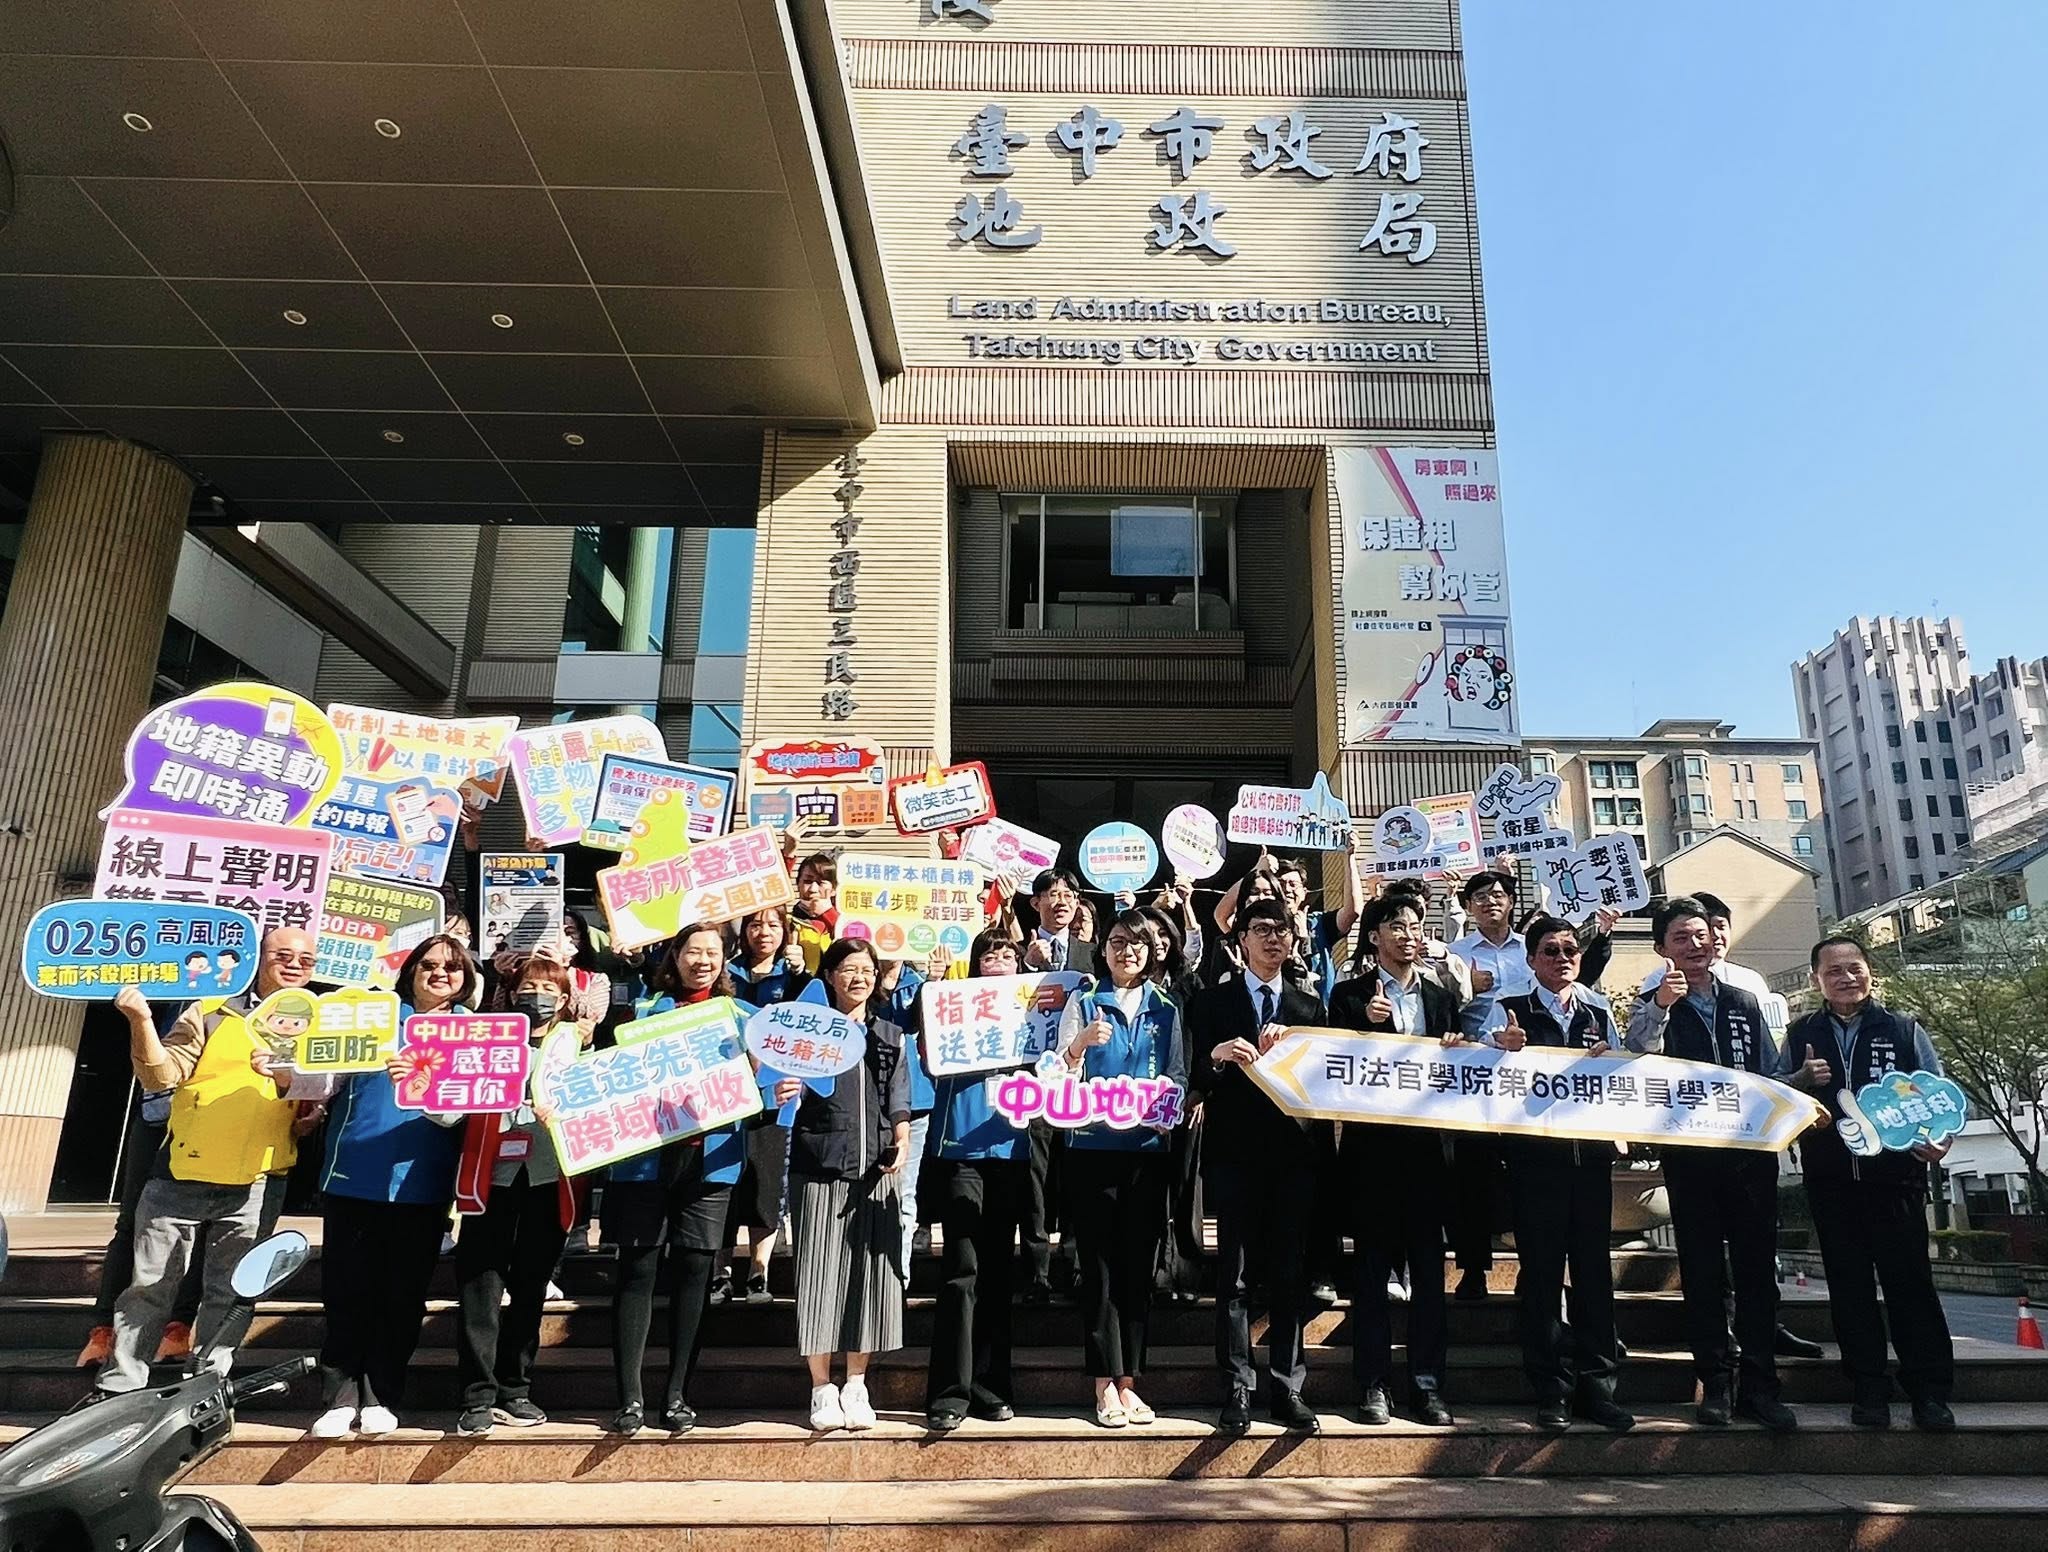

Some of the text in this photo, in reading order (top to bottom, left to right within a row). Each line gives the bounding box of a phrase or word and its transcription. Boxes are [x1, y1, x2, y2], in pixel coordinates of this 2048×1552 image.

[957, 104, 1430, 182] 臺中市政府
[955, 187, 1437, 265] 地政局
[948, 295, 1452, 328] Land Administration Bureau,
[966, 333, 1438, 366] Taichung City Government
[1445, 484, 1497, 501] 照過來
[332, 710, 492, 750] 新制土地複丈
[148, 710, 329, 792] 地籍異動
[394, 750, 498, 781] 以量計費
[150, 760, 290, 825] 即時通
[905, 784, 976, 814] 微笑志工
[313, 804, 391, 835] 約申報
[1502, 816, 1543, 838] 衛星
[108, 834, 320, 894] 線上聲明
[605, 831, 777, 911] 跨所登記
[846, 862, 974, 887] 地籍謄本櫃員機
[1588, 845, 1622, 907] 無人機
[325, 896, 402, 923] 在簽約日起
[695, 873, 786, 918] 全國通
[845, 889, 919, 913] 簡單4步驟
[931, 888, 968, 904] 謄本
[923, 906, 975, 922] 就到手
[46, 918, 246, 958] 0256 高風險
[319, 1001, 391, 1031] 全民
[769, 1007, 849, 1041] 地政局
[935, 988, 1000, 1026] 指定
[413, 1020, 519, 1043] 中山志工
[306, 1034, 379, 1064] 國防
[451, 1046, 521, 1075] 感恩
[762, 1033, 843, 1067] 地籍科
[548, 1025, 729, 1112] 遠途先審
[1325, 1053, 1741, 1114] 司法官學院第66期學員學習
[437, 1077, 507, 1106] 有你
[999, 1075, 1182, 1122] 中山地政
[562, 1071, 751, 1162] 跨域代收
[1875, 1090, 1958, 1129] 地籍科
